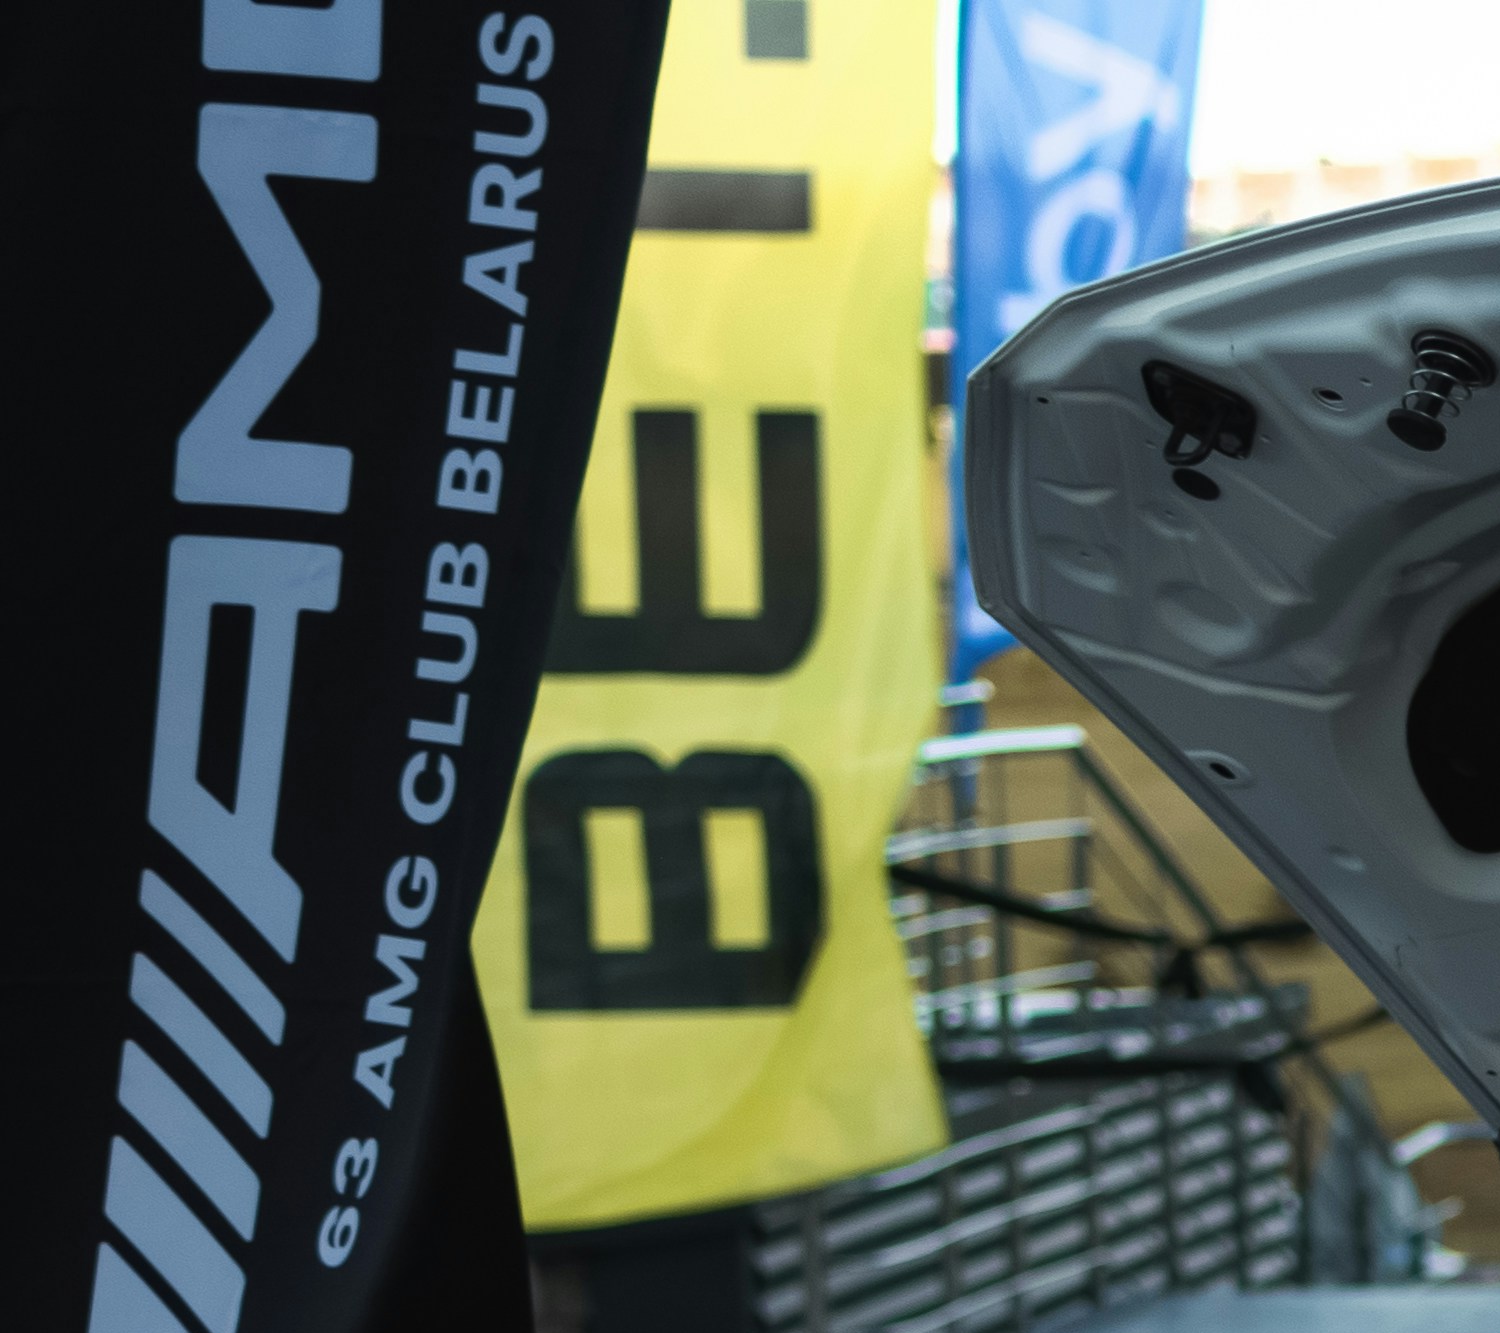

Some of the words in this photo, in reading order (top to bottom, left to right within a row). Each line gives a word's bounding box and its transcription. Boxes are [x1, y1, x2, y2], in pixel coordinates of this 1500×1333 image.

[437, 11, 555, 514] BELARUS
[148, 0, 386, 963] AM
[400, 541, 490, 826] CLUB
[353, 855, 441, 1111] AMG
[316, 1137, 379, 1268] 63
